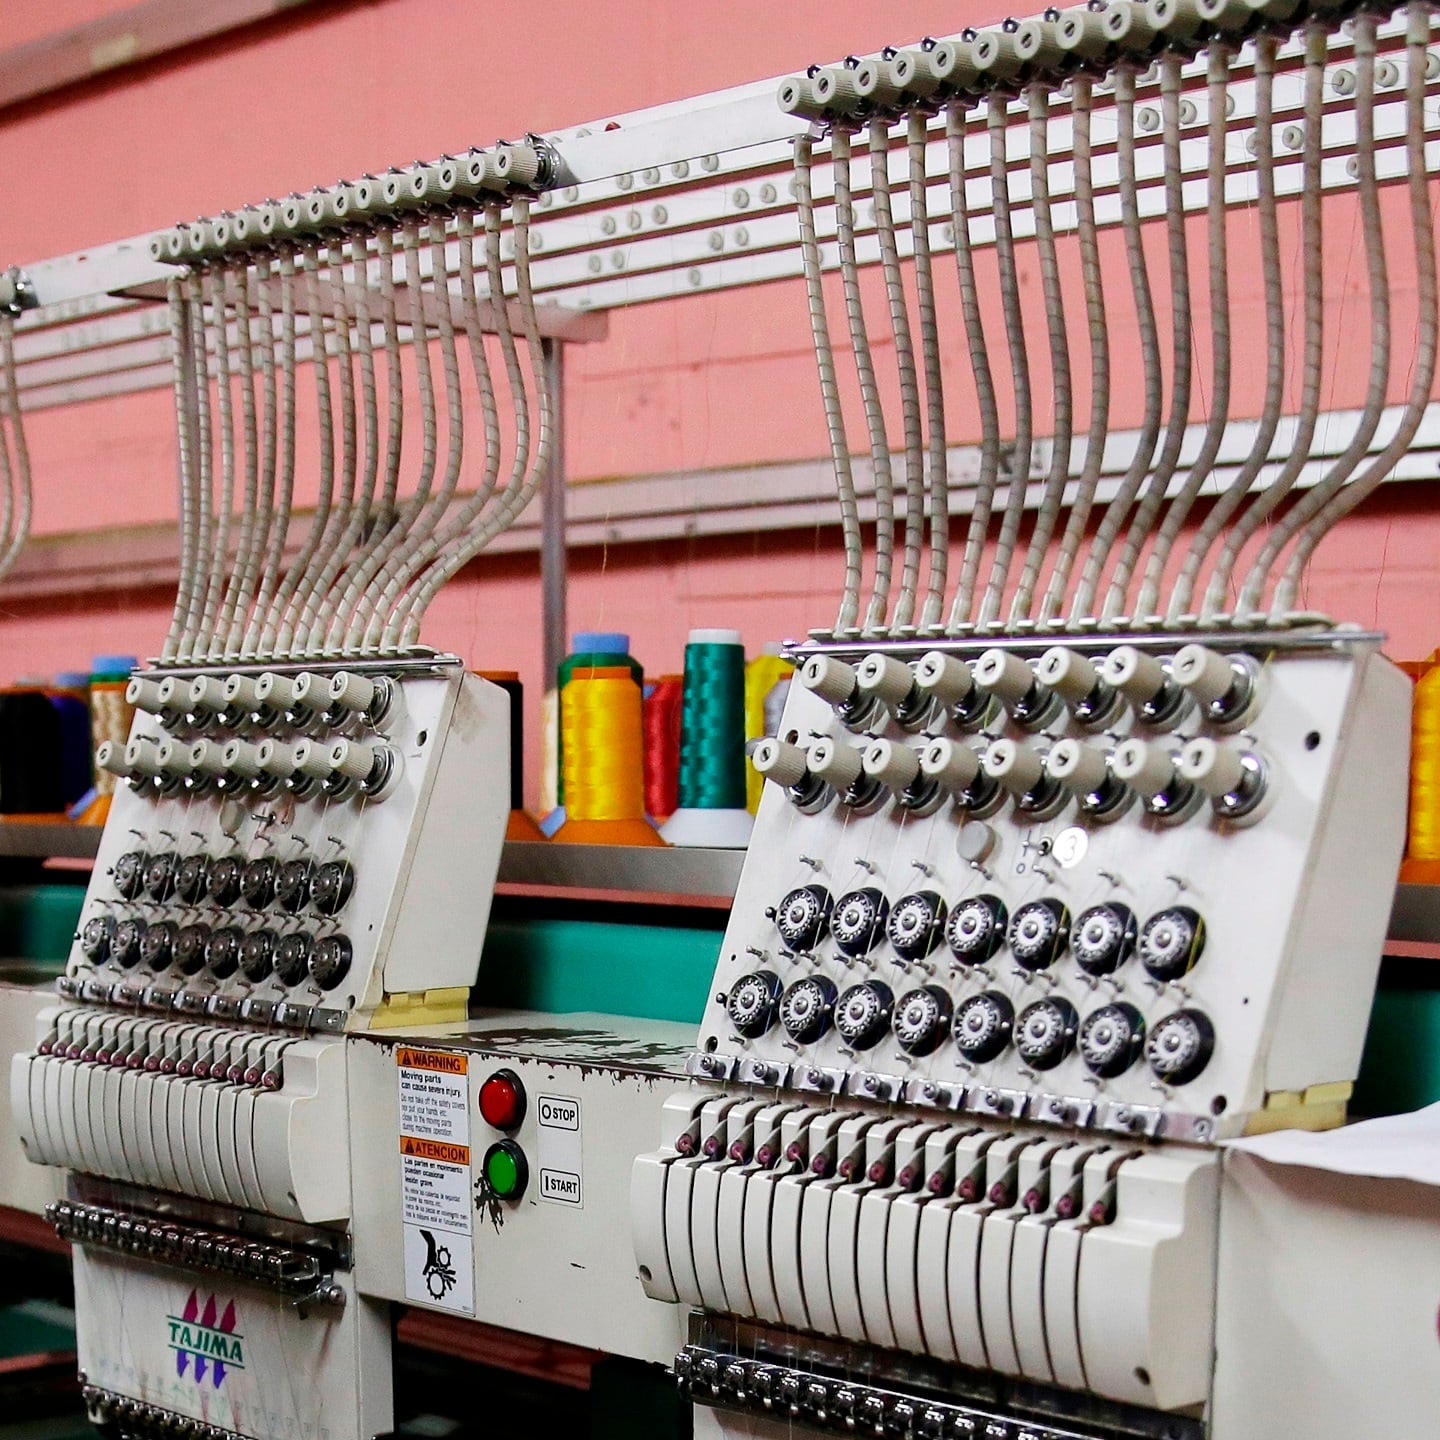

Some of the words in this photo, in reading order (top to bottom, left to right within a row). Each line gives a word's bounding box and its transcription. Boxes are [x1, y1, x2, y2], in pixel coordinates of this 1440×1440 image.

[1062, 834, 1078, 862] 3
[412, 1052, 461, 1071] WARNING
[401, 1070, 423, 1083] Moving
[424, 1074, 442, 1084] parts
[552, 1107, 576, 1122] STOP
[415, 1142, 466, 1162] ATENCION
[550, 1178, 578, 1194] START
[167, 1322, 244, 1363] TAJIMA
